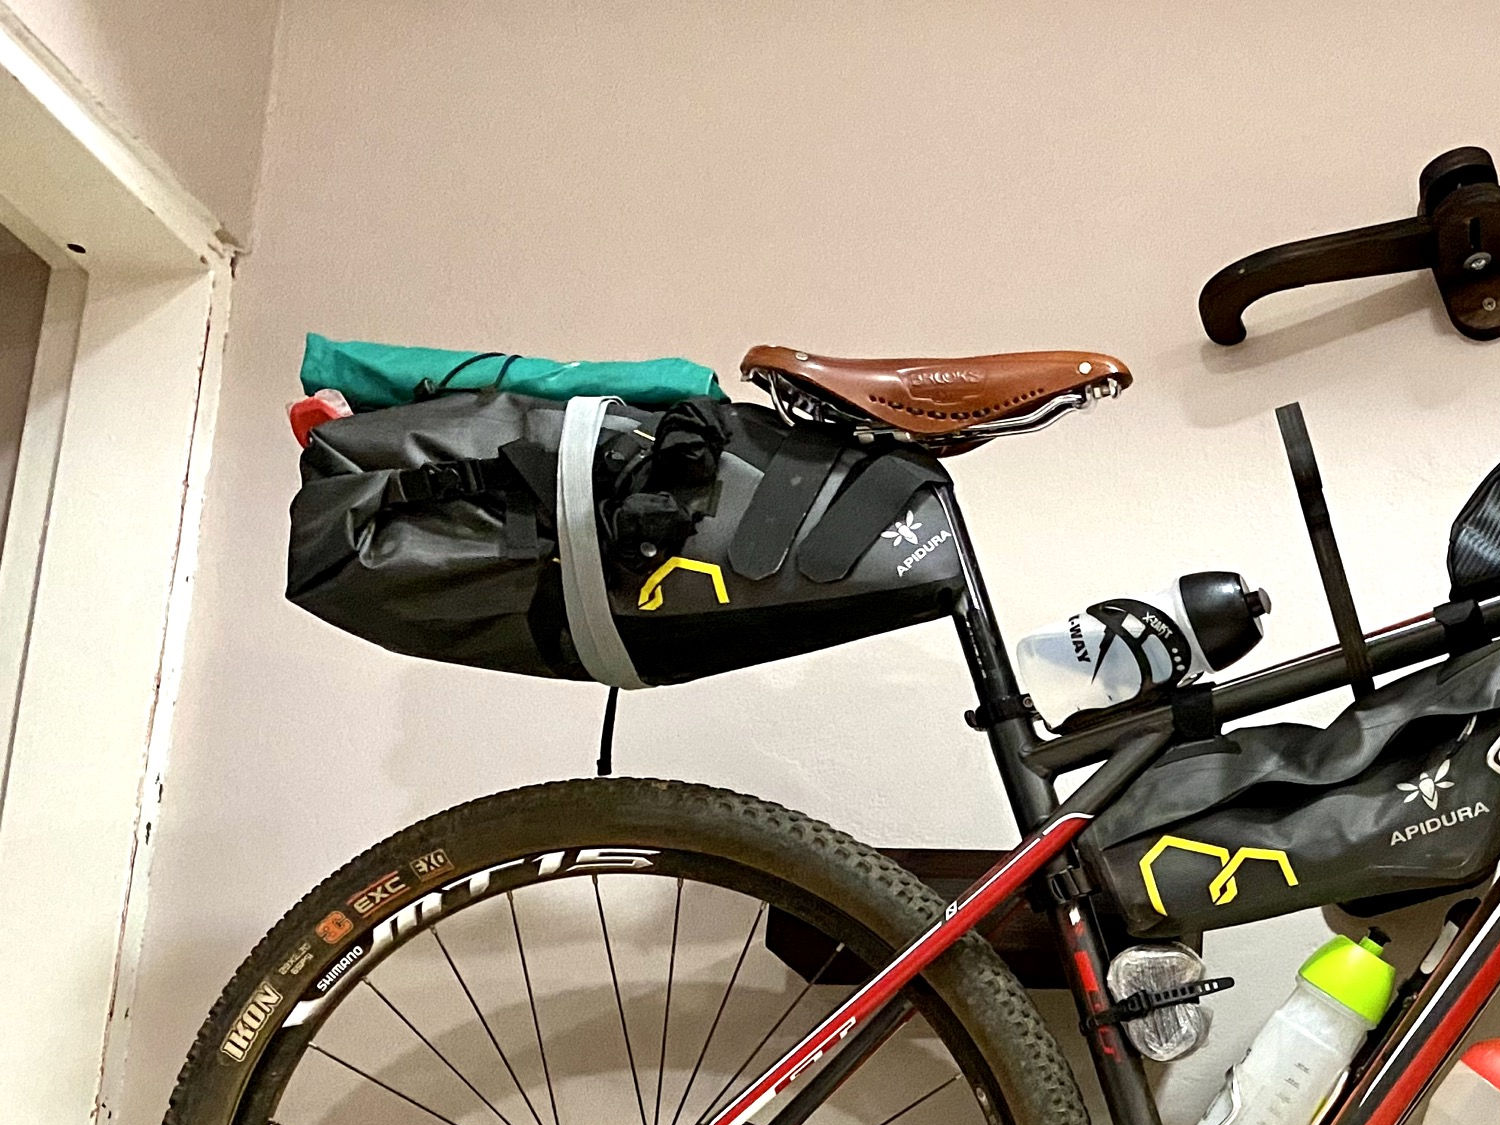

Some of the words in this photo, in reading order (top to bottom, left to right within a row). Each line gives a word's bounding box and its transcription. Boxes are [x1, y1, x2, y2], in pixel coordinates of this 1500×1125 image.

[896, 529, 951, 577] APIDURA
[1390, 801, 1490, 847] APIDURA
[353, 875, 407, 915] EXC
[316, 945, 364, 994] SHIMANO
[220, 980, 284, 1062] IKON
